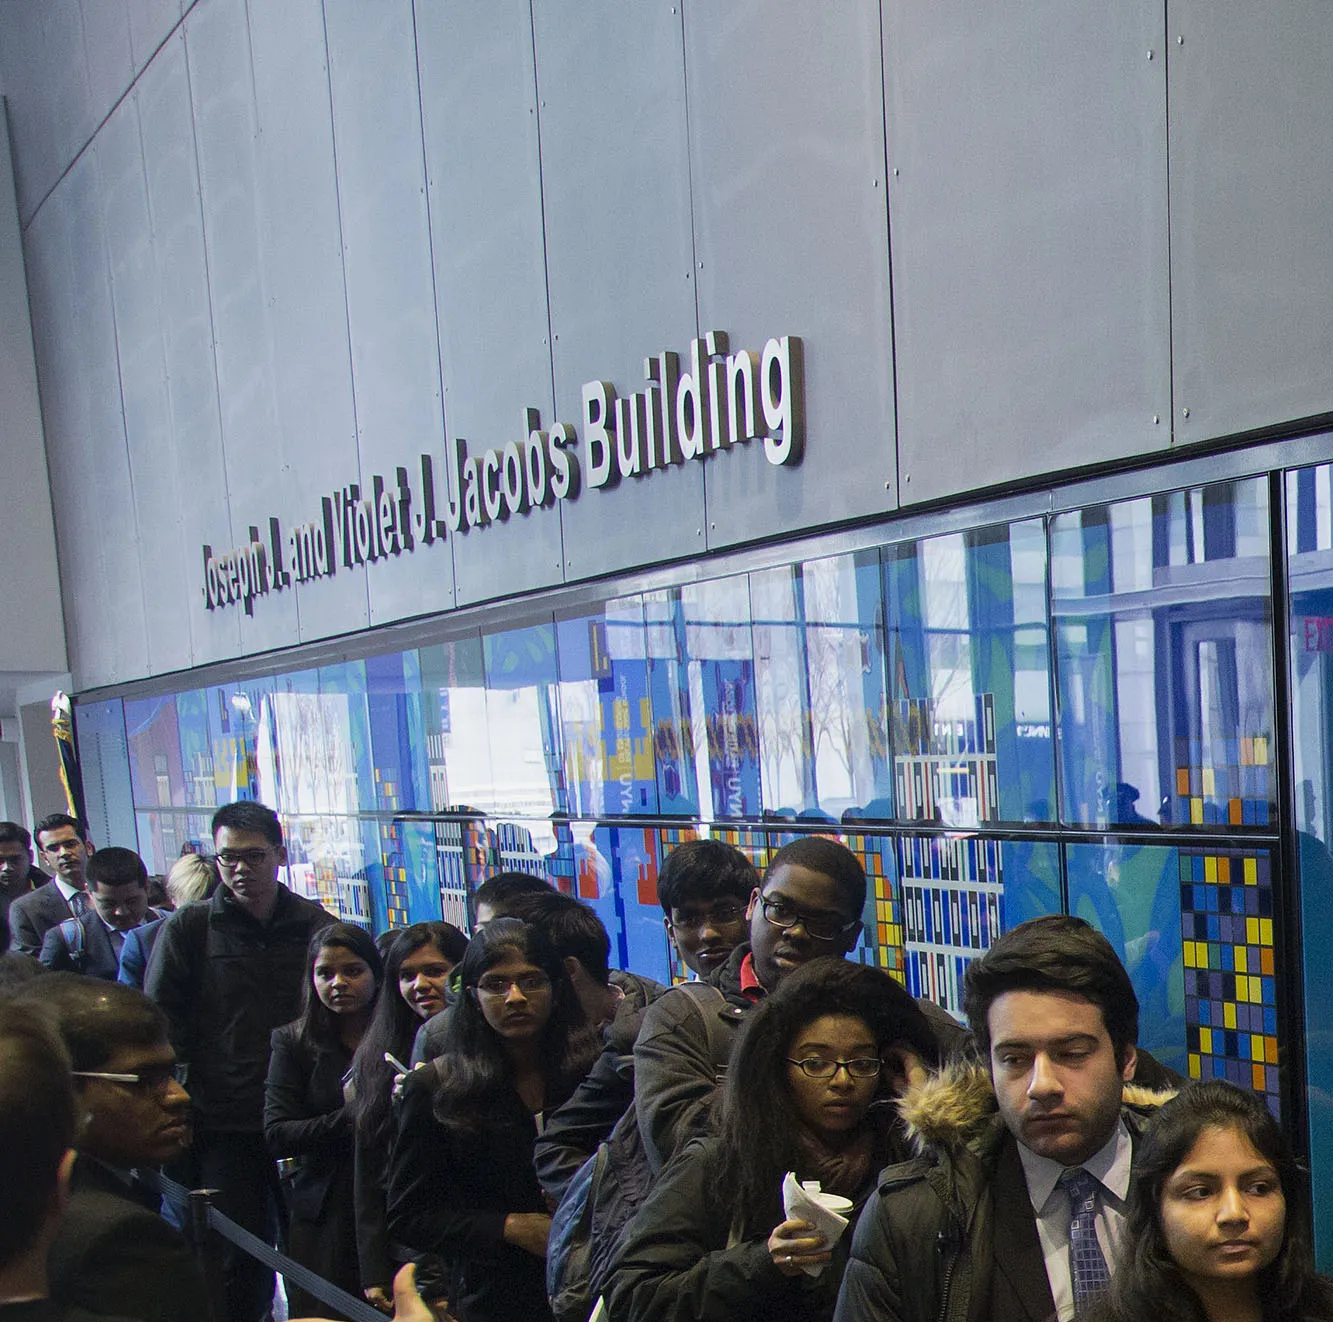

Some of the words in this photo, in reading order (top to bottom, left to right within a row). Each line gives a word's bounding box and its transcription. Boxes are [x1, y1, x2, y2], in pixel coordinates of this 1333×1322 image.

[202, 526, 268, 617] Joseph
[265, 517, 290, 589] J.
[290, 497, 335, 586] and
[331, 467, 415, 569] Violet
[413, 454, 446, 543] J.
[447, 407, 580, 531] Jacobs
[582, 330, 805, 488] Building
